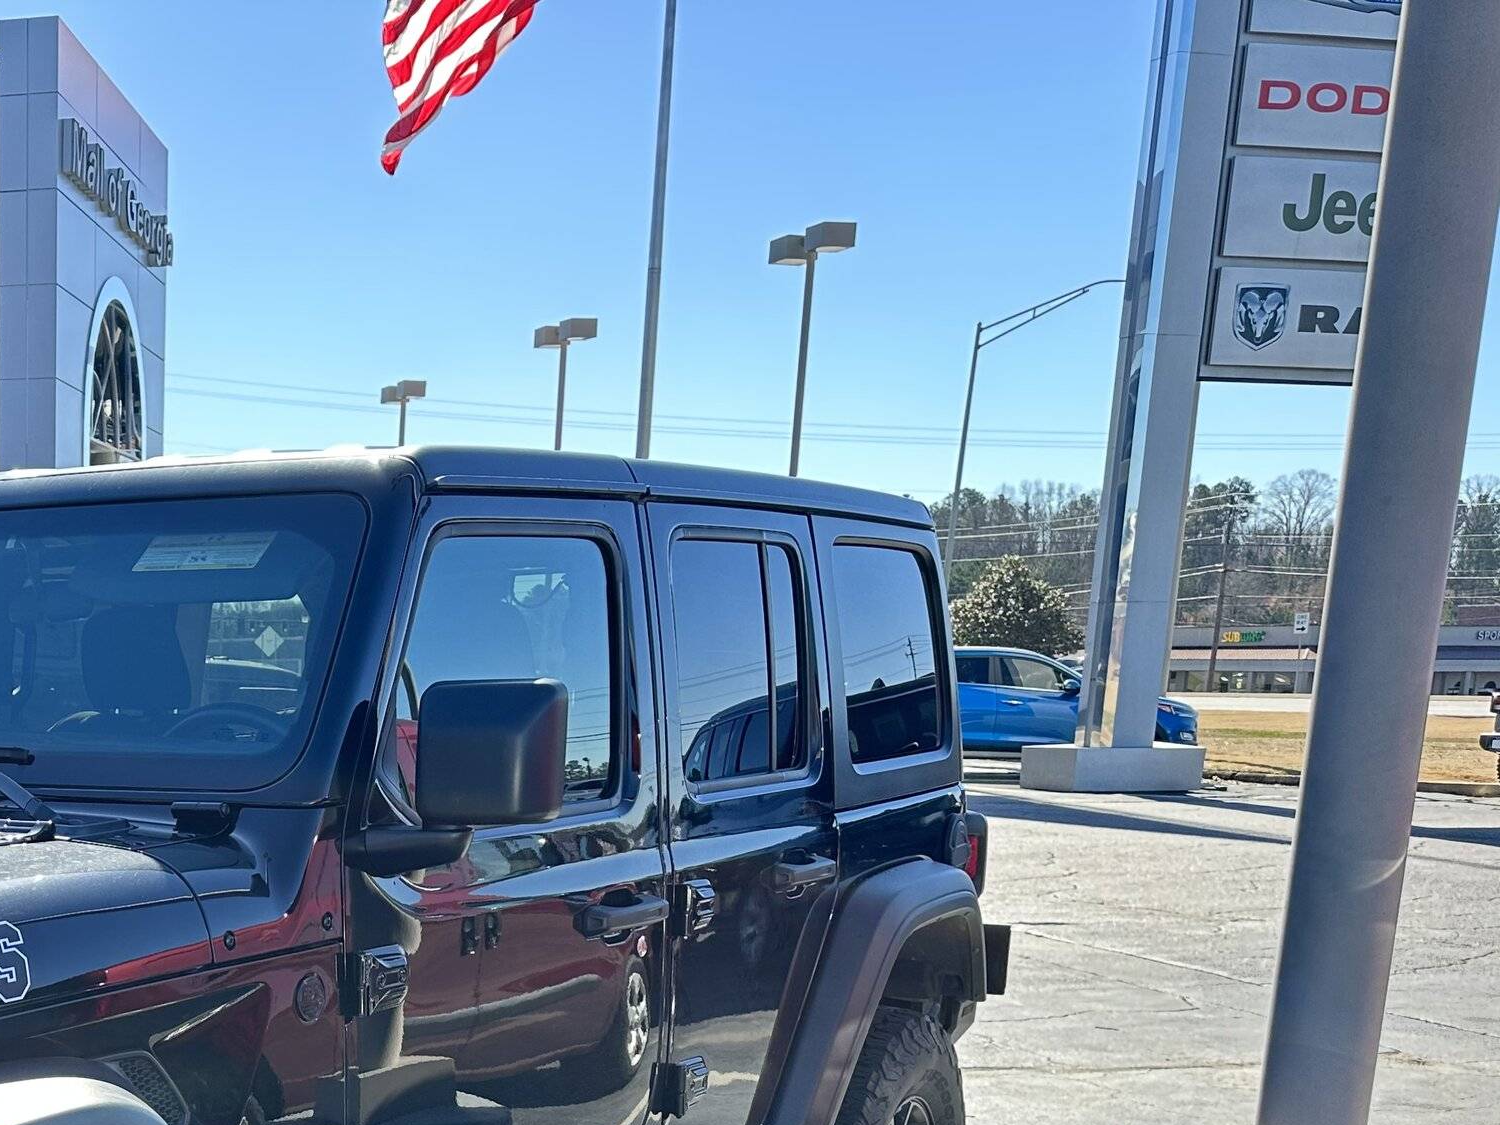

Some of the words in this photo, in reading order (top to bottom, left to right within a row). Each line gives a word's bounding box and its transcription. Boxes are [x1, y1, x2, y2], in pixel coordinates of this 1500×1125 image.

[64, 119, 105, 201] Mall
[107, 168, 126, 217] of
[126, 180, 174, 266] Georgia
